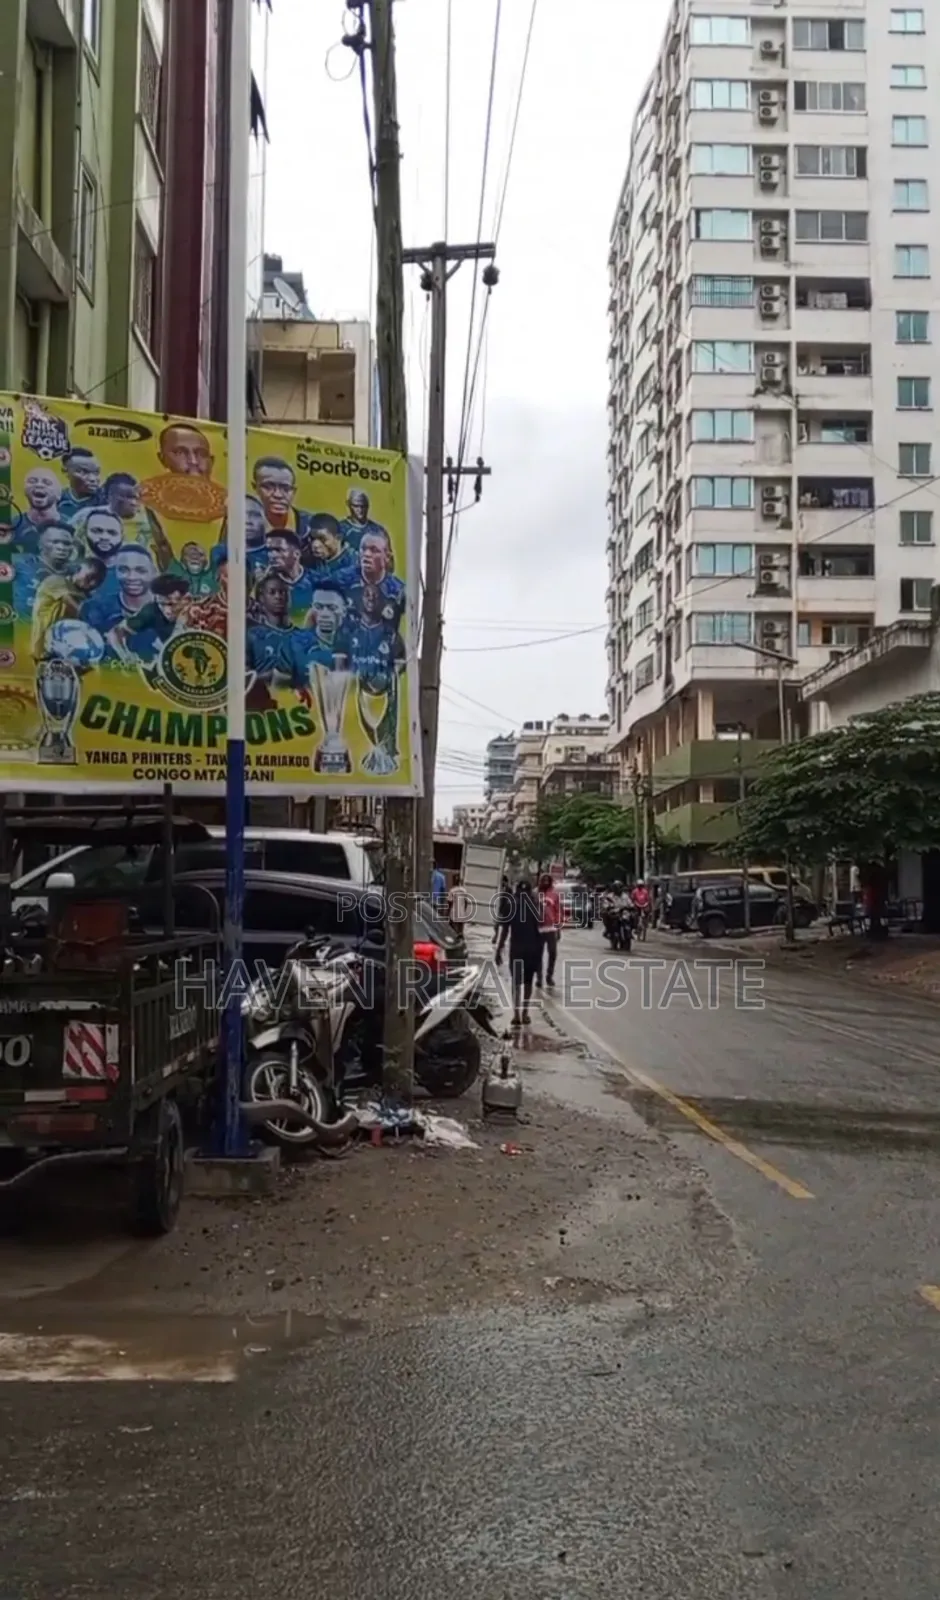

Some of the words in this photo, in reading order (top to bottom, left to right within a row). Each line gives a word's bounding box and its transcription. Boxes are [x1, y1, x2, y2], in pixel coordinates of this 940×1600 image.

[23, 434, 69, 451] LEAGUE
[296, 443, 322, 455] Main
[325, 447, 346, 458] Club
[296, 453, 392, 483] SportPesa
[79, 694, 317, 748] CHAMPONS
[86, 751, 128, 765] YANGA
[132, 752, 193, 766] PRINTERS
[255, 755, 310, 768] KARIAKOO
[132, 768, 190, 781] CONGO
[194, 769, 275, 782] MTABANI
